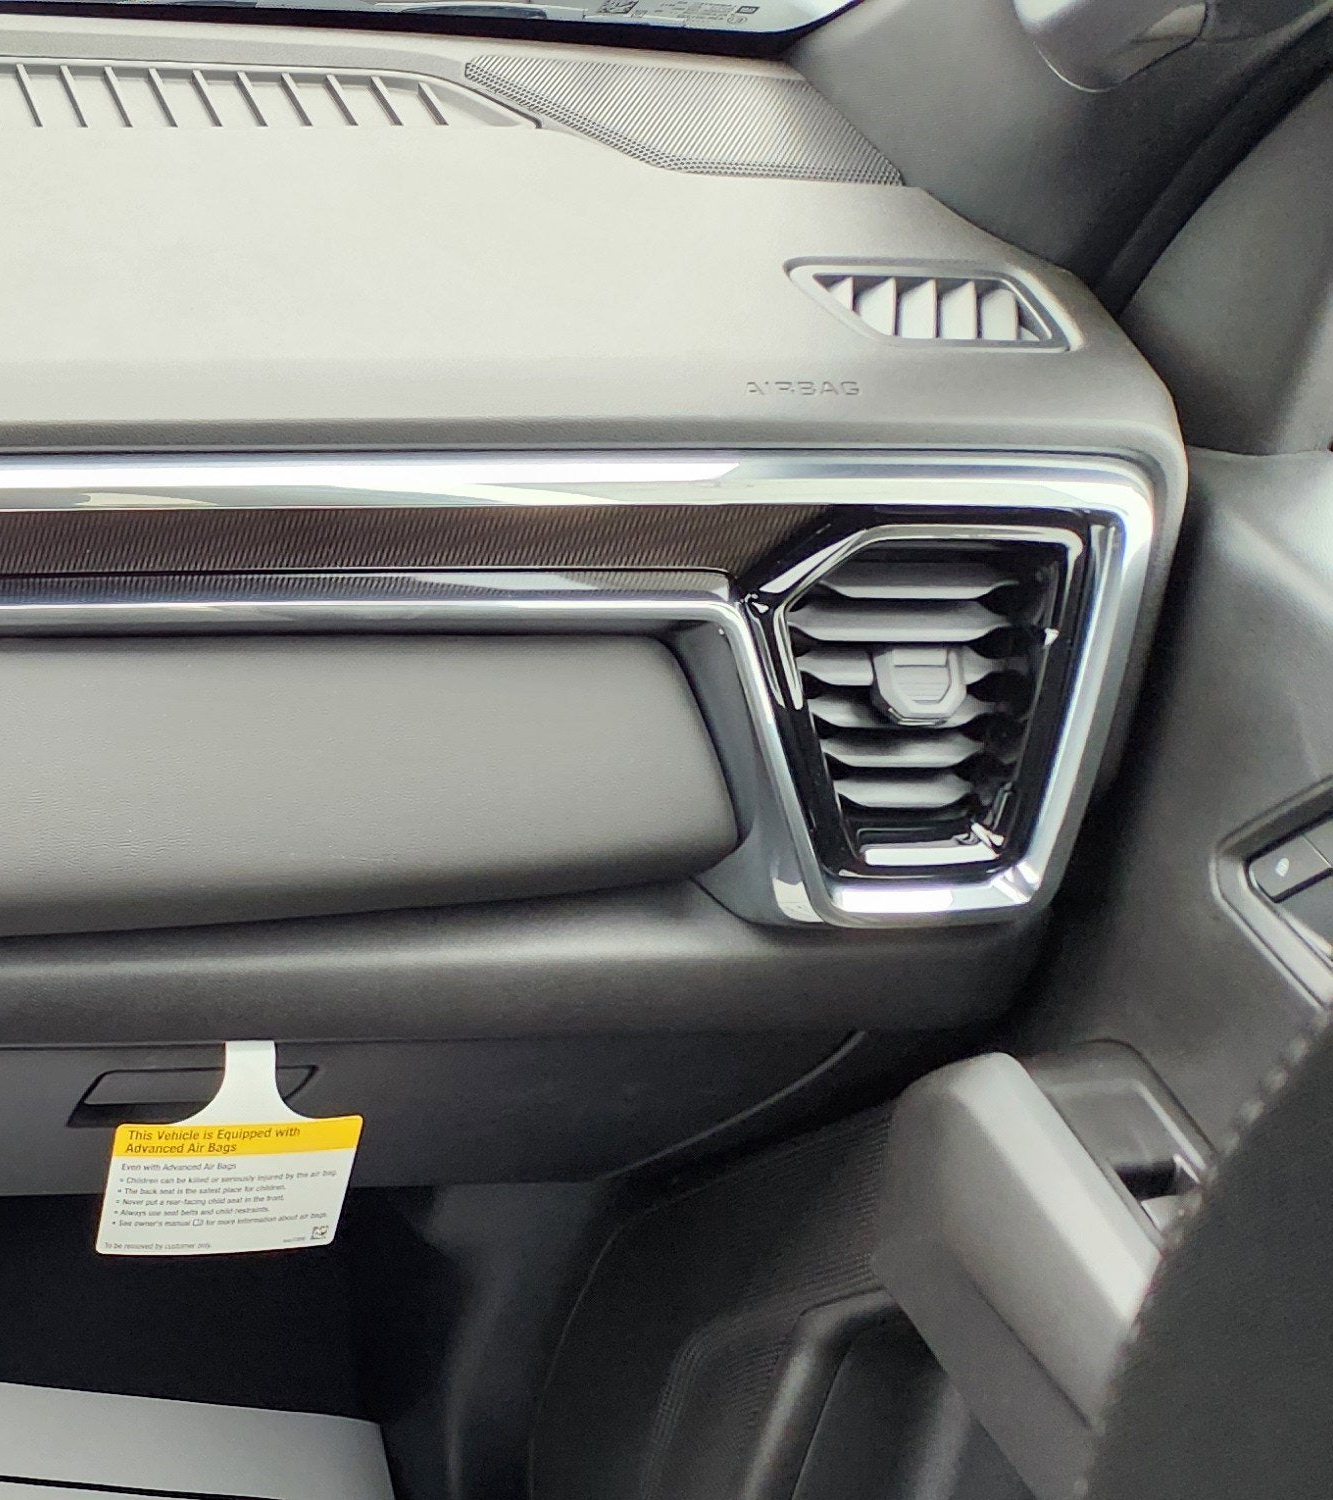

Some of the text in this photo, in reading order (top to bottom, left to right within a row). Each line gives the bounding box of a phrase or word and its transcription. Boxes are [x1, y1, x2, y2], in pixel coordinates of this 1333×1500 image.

[744, 381, 860, 396] AIRBAG
[128, 1127, 300, 1142] This Vehicle is Equipped with
[125, 1142, 237, 1154] Advanced Air Bags
[121, 1163, 237, 1172] Even with Advanced Air Bags
